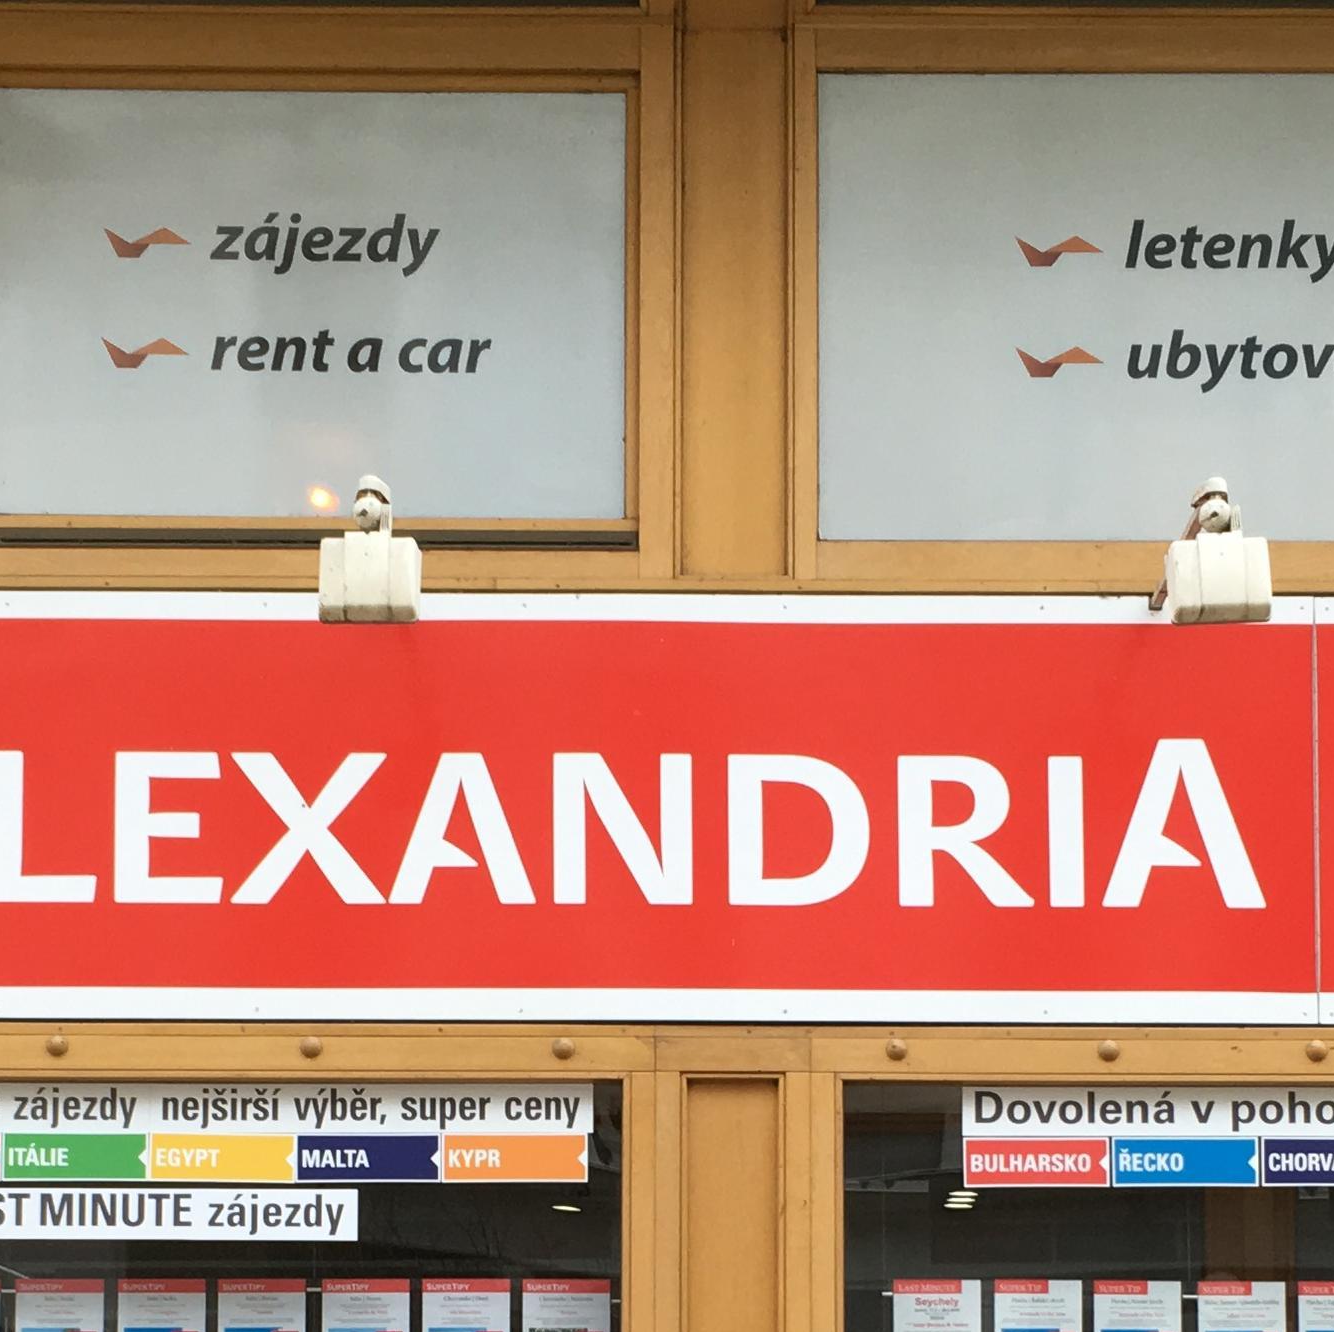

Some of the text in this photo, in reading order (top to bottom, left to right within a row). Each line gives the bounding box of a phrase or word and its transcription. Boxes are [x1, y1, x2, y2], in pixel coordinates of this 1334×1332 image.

[210, 212, 440, 277] zájezdy
[211, 329, 491, 373] rent a car
[14, 1087, 137, 1128] zájezdy
[162, 1088, 279, 1128] nejširší
[294, 1088, 386, 1129] výběr,
[400, 1094, 491, 1129] super
[504, 1095, 580, 1128] ceny
[975, 1090, 1174, 1124] Dovolená
[1191, 1100, 1215, 1123] v
[9, 1143, 69, 1166] ITÁLIE
[156, 1148, 220, 1167] EGYPT
[302, 1150, 369, 1168] MALTA
[449, 1149, 500, 1167] KYPR
[971, 1154, 1091, 1172] BULHARSKO
[1119, 1149, 1183, 1171] ŘECKO
[40, 1193, 192, 1227] MINUTE
[208, 1194, 344, 1235] zájezdy
